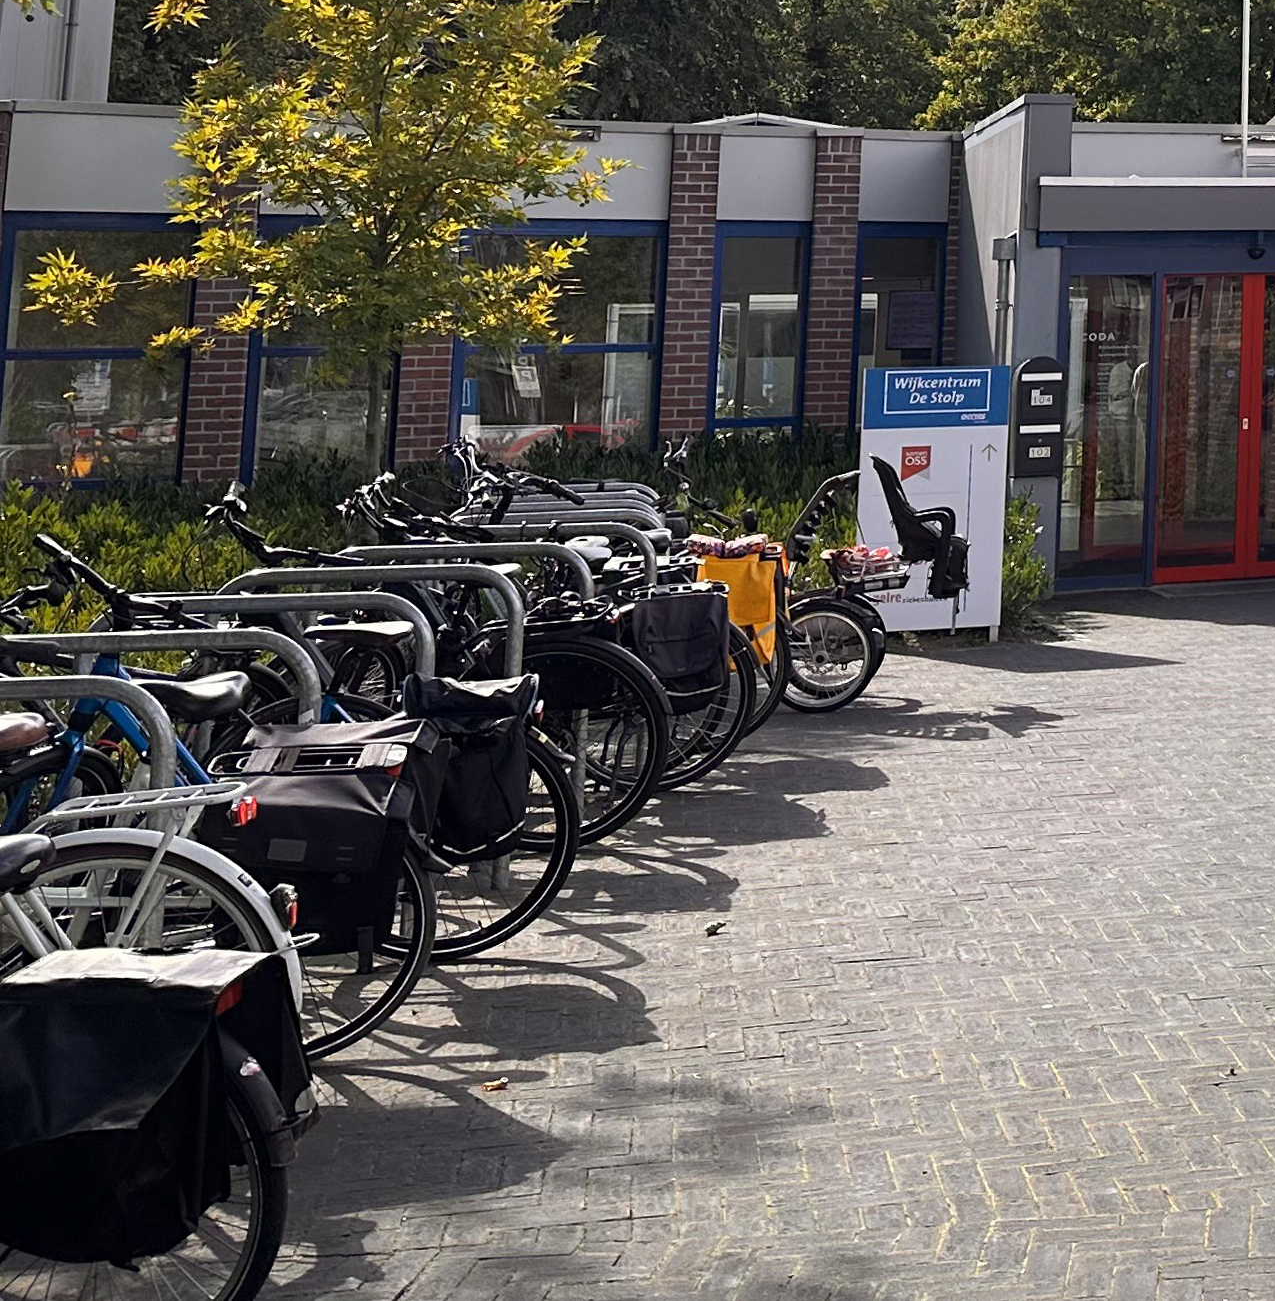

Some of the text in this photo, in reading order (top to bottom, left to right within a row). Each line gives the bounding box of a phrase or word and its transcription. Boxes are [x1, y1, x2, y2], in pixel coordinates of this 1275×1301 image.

[1082, 332, 1115, 342] CODA
[894, 376, 981, 393] Wijkcentrum
[909, 390, 965, 406] De Stolp
[1030, 448, 1050, 457] 102
